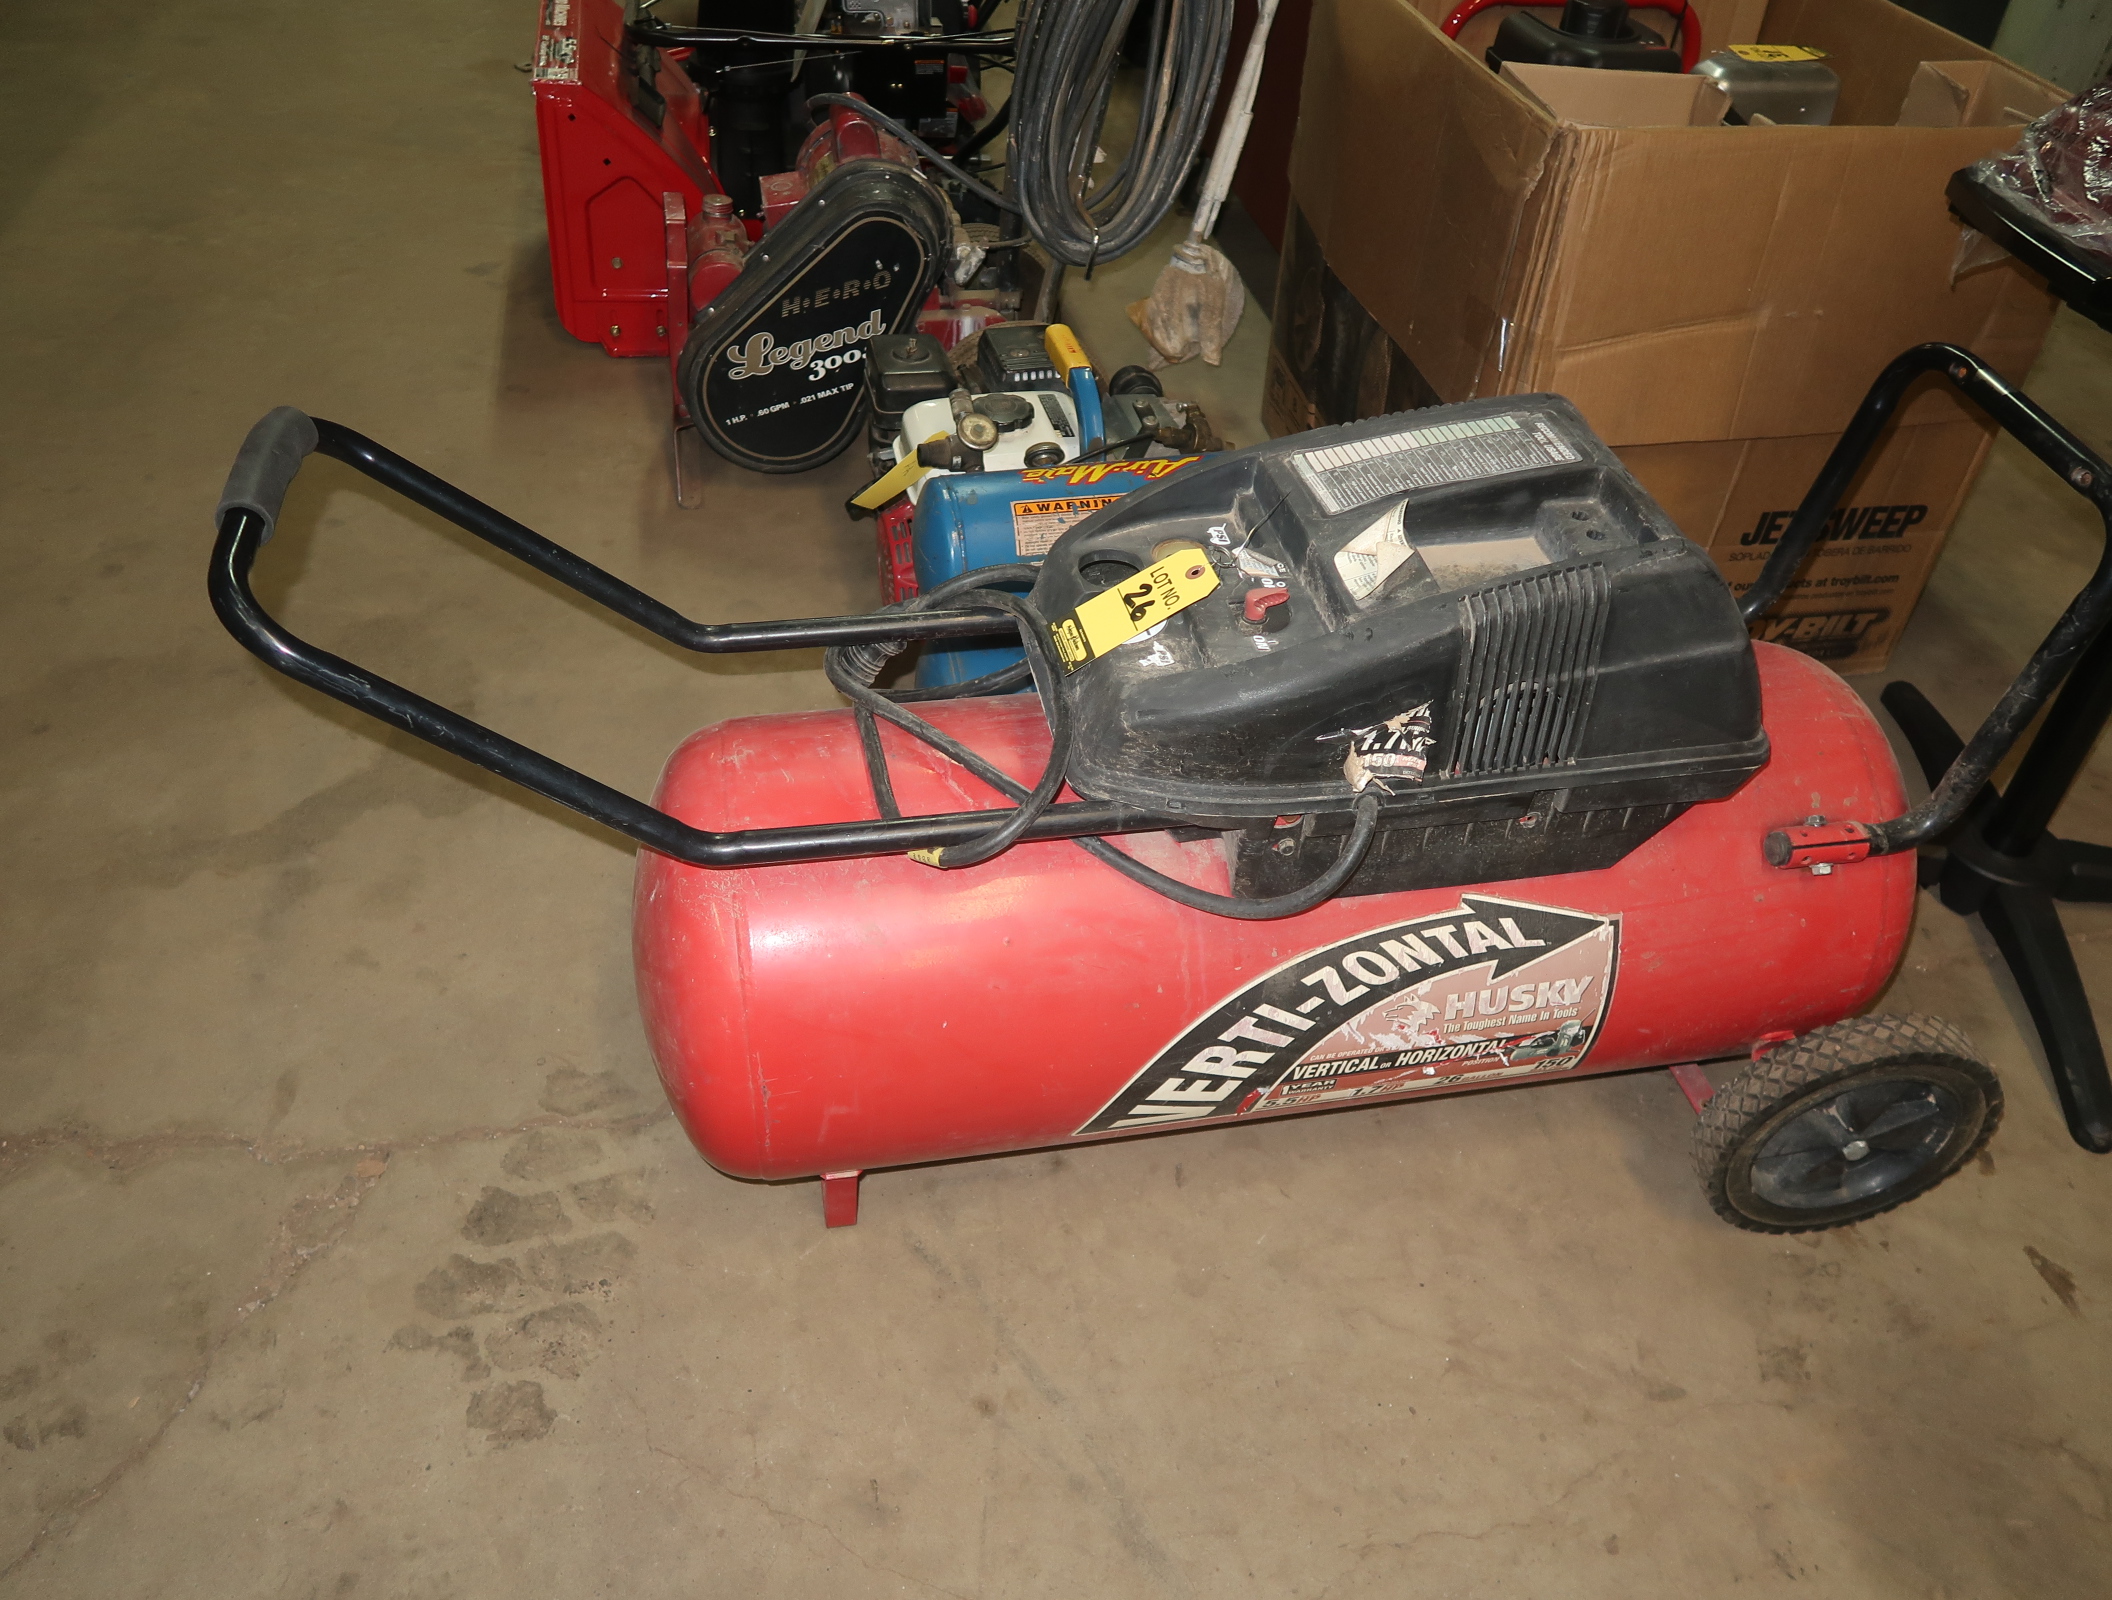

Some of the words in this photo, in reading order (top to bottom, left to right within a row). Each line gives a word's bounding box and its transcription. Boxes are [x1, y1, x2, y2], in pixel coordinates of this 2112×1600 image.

[726, 308, 887, 381] Legend
[808, 347, 867, 381] 300
[770, 401, 790, 413] GPM
[817, 388, 839, 399] MAX
[840, 382, 854, 392] TIP
[1542, 443, 1564, 462] USAGE
[1037, 498, 1114, 512] WARNIN
[1149, 565, 1172, 590] LOT
[1815, 577, 1829, 587] at
[1831, 574, 1900, 588] troybilt.com
[1123, 583, 1156, 622] 26
[1160, 586, 1181, 611] NO.
[1253, 635, 1272, 652] ON
[1363, 753, 1396, 767] 150
[1444, 975, 1595, 1021] HUSKY
[1107, 917, 1547, 1129] VERTI-ZONTAL
[1443, 1022, 1461, 1034] The
[1463, 1016, 1507, 1032] Toughest
[1508, 1014, 1538, 1026] Name
[1540, 1011, 1551, 1021] In
[1553, 1007, 1578, 1019] Tools
[1292, 1056, 1379, 1081] VERTICAL
[1379, 1061, 1392, 1069] OR
[1394, 1039, 1506, 1067] HORIZONTAL
[1310, 1054, 1325, 1062] CAN
[1337, 1048, 1373, 1058] OPERATED
[1462, 1056, 1500, 1066] POSITION
[1281, 1085, 1290, 1096] 1
[1291, 1079, 1337, 1090] YEAR
[1288, 1085, 1335, 1095] WARRANTY
